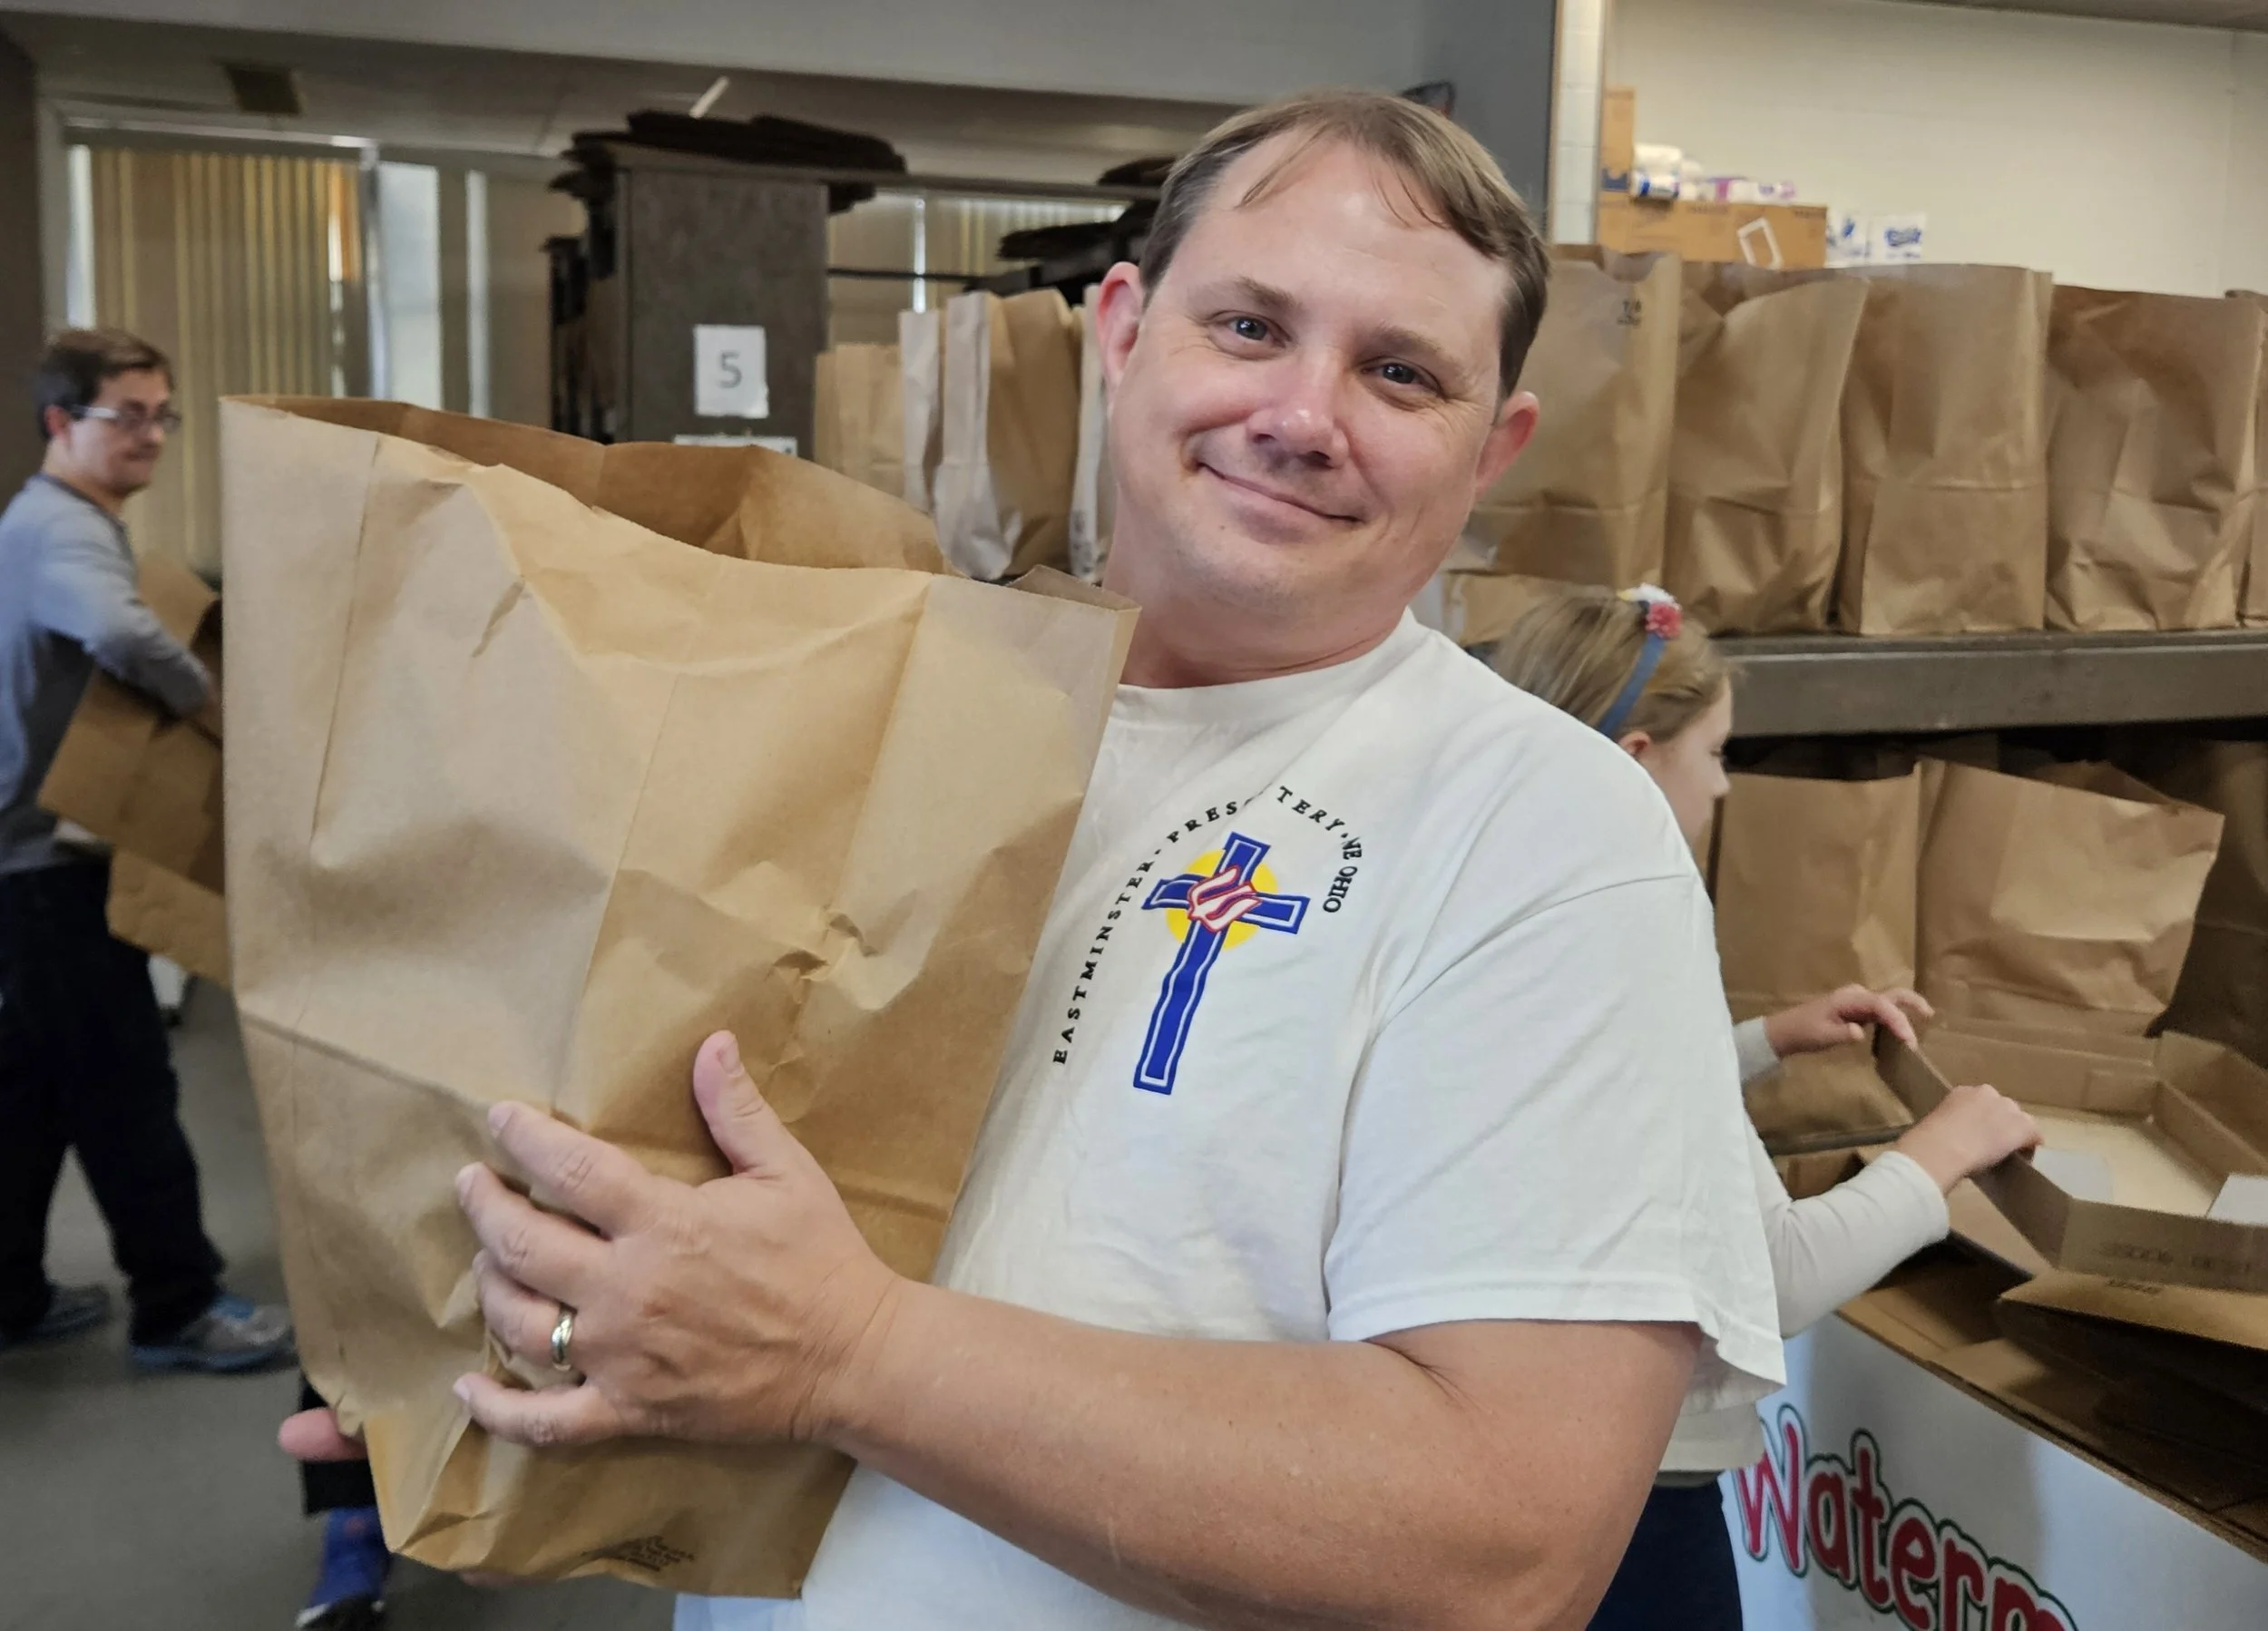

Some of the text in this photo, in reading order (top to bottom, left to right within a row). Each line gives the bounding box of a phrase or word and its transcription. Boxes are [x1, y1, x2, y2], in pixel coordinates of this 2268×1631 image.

[718, 351, 742, 389] 5
[1052, 856, 1154, 1065] EASTMINSTER
[1167, 786, 1345, 844] PRESTERY
[1322, 865, 1358, 913] OHIO
